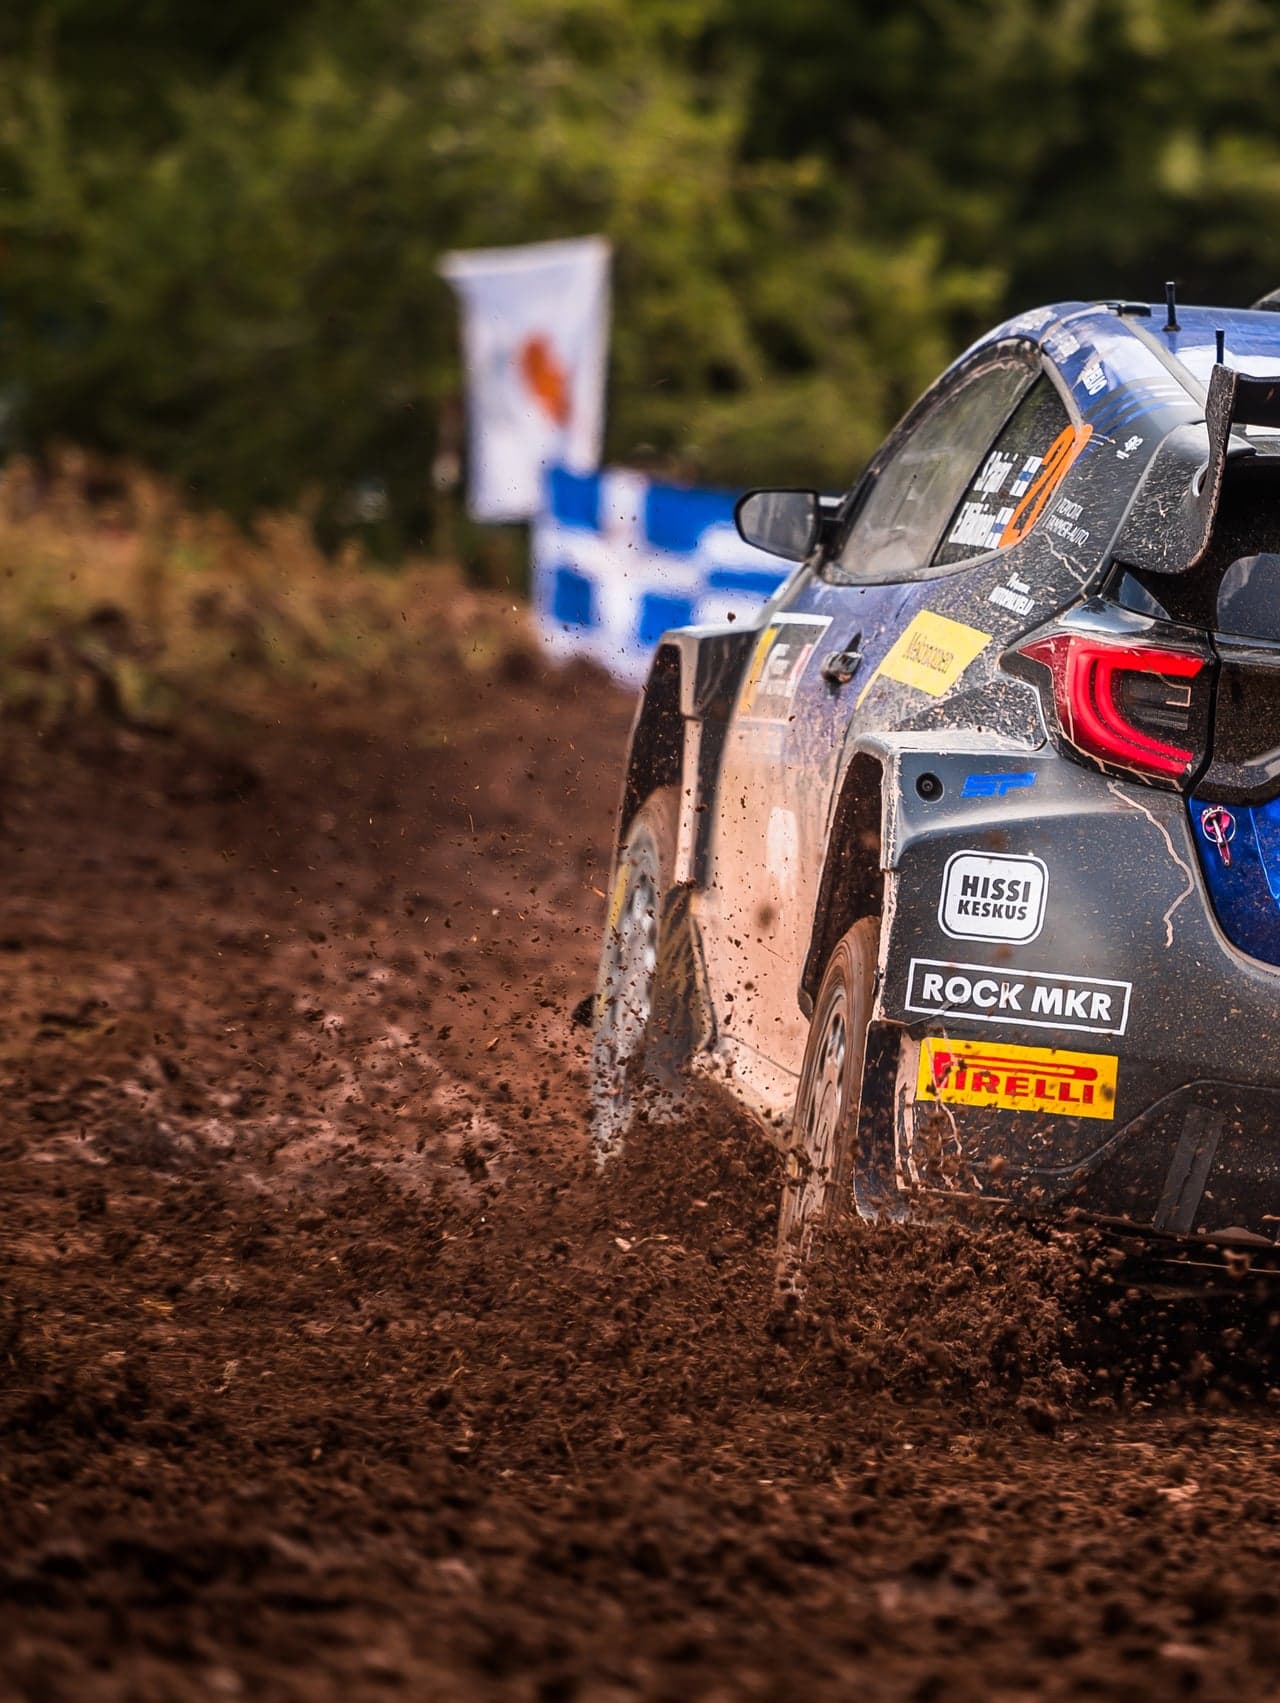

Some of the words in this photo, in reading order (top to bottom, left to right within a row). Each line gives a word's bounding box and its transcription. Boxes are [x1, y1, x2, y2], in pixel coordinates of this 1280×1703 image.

[960, 873, 1032, 903] HISSI
[956, 898, 1028, 922] KESKUS
[921, 972, 1025, 1011] ROCK
[1030, 986, 1113, 1021] MKR
[931, 1050, 1098, 1105] PIRELLI
